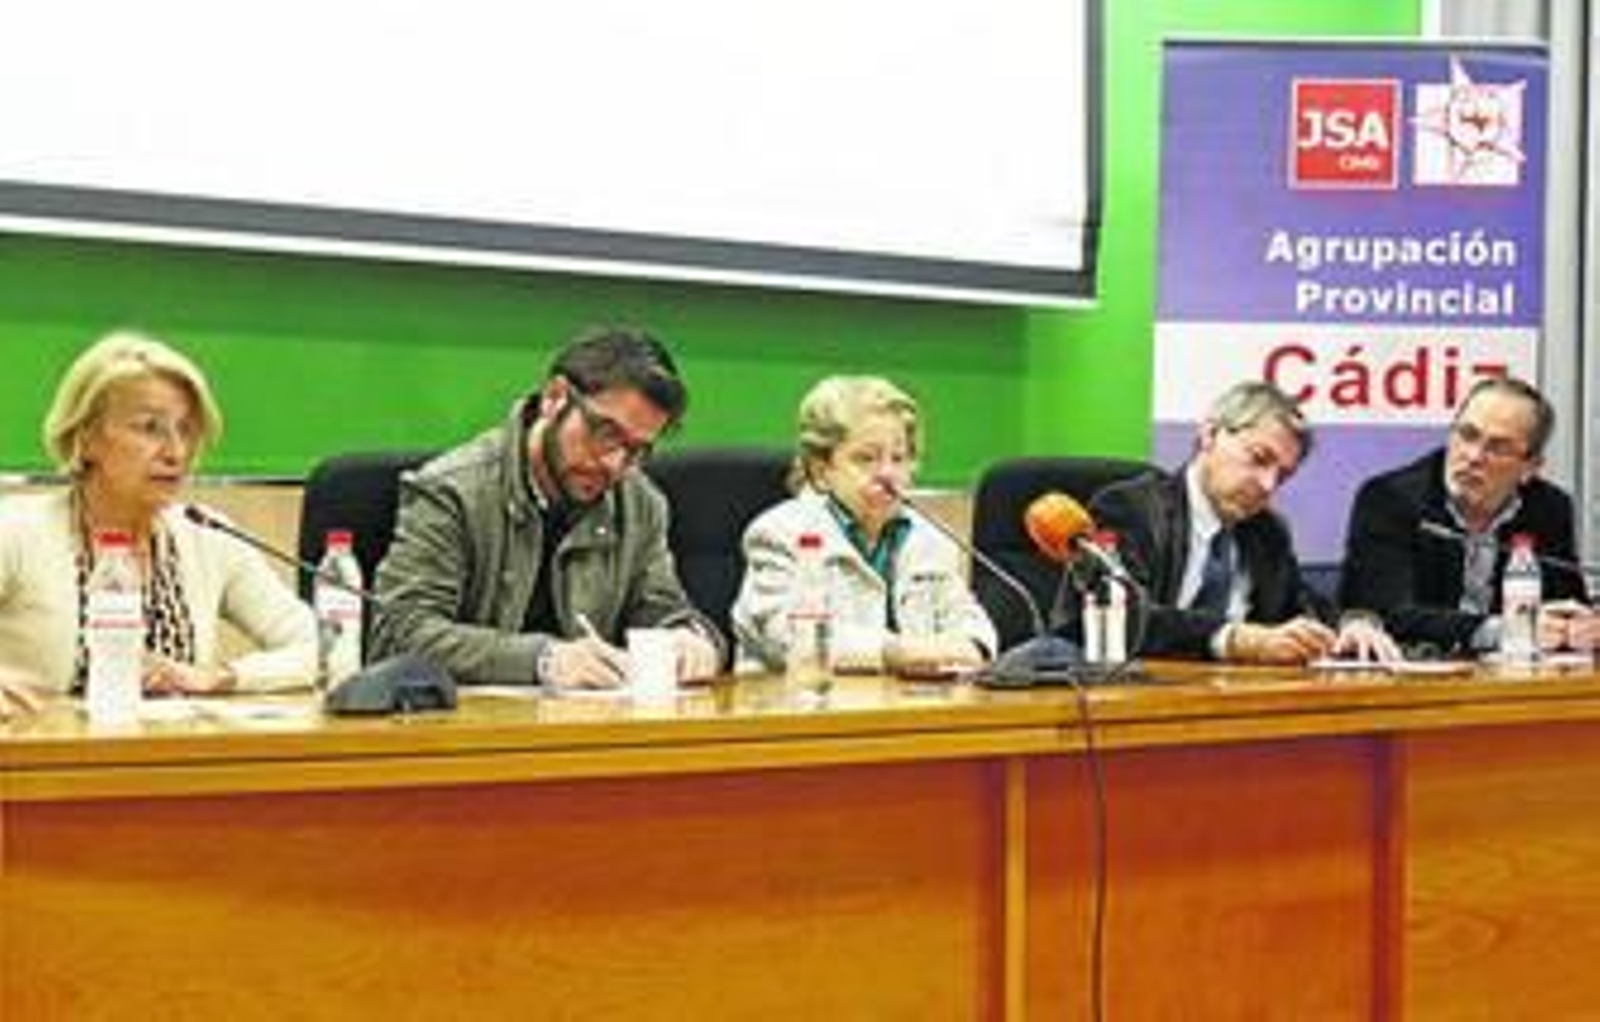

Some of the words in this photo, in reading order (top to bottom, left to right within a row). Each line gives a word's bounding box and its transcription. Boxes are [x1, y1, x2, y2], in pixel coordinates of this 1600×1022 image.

[1298, 109, 1389, 150] JSA
[1266, 230, 1516, 269] Agrupación
[1296, 281, 1515, 315] Provincial
